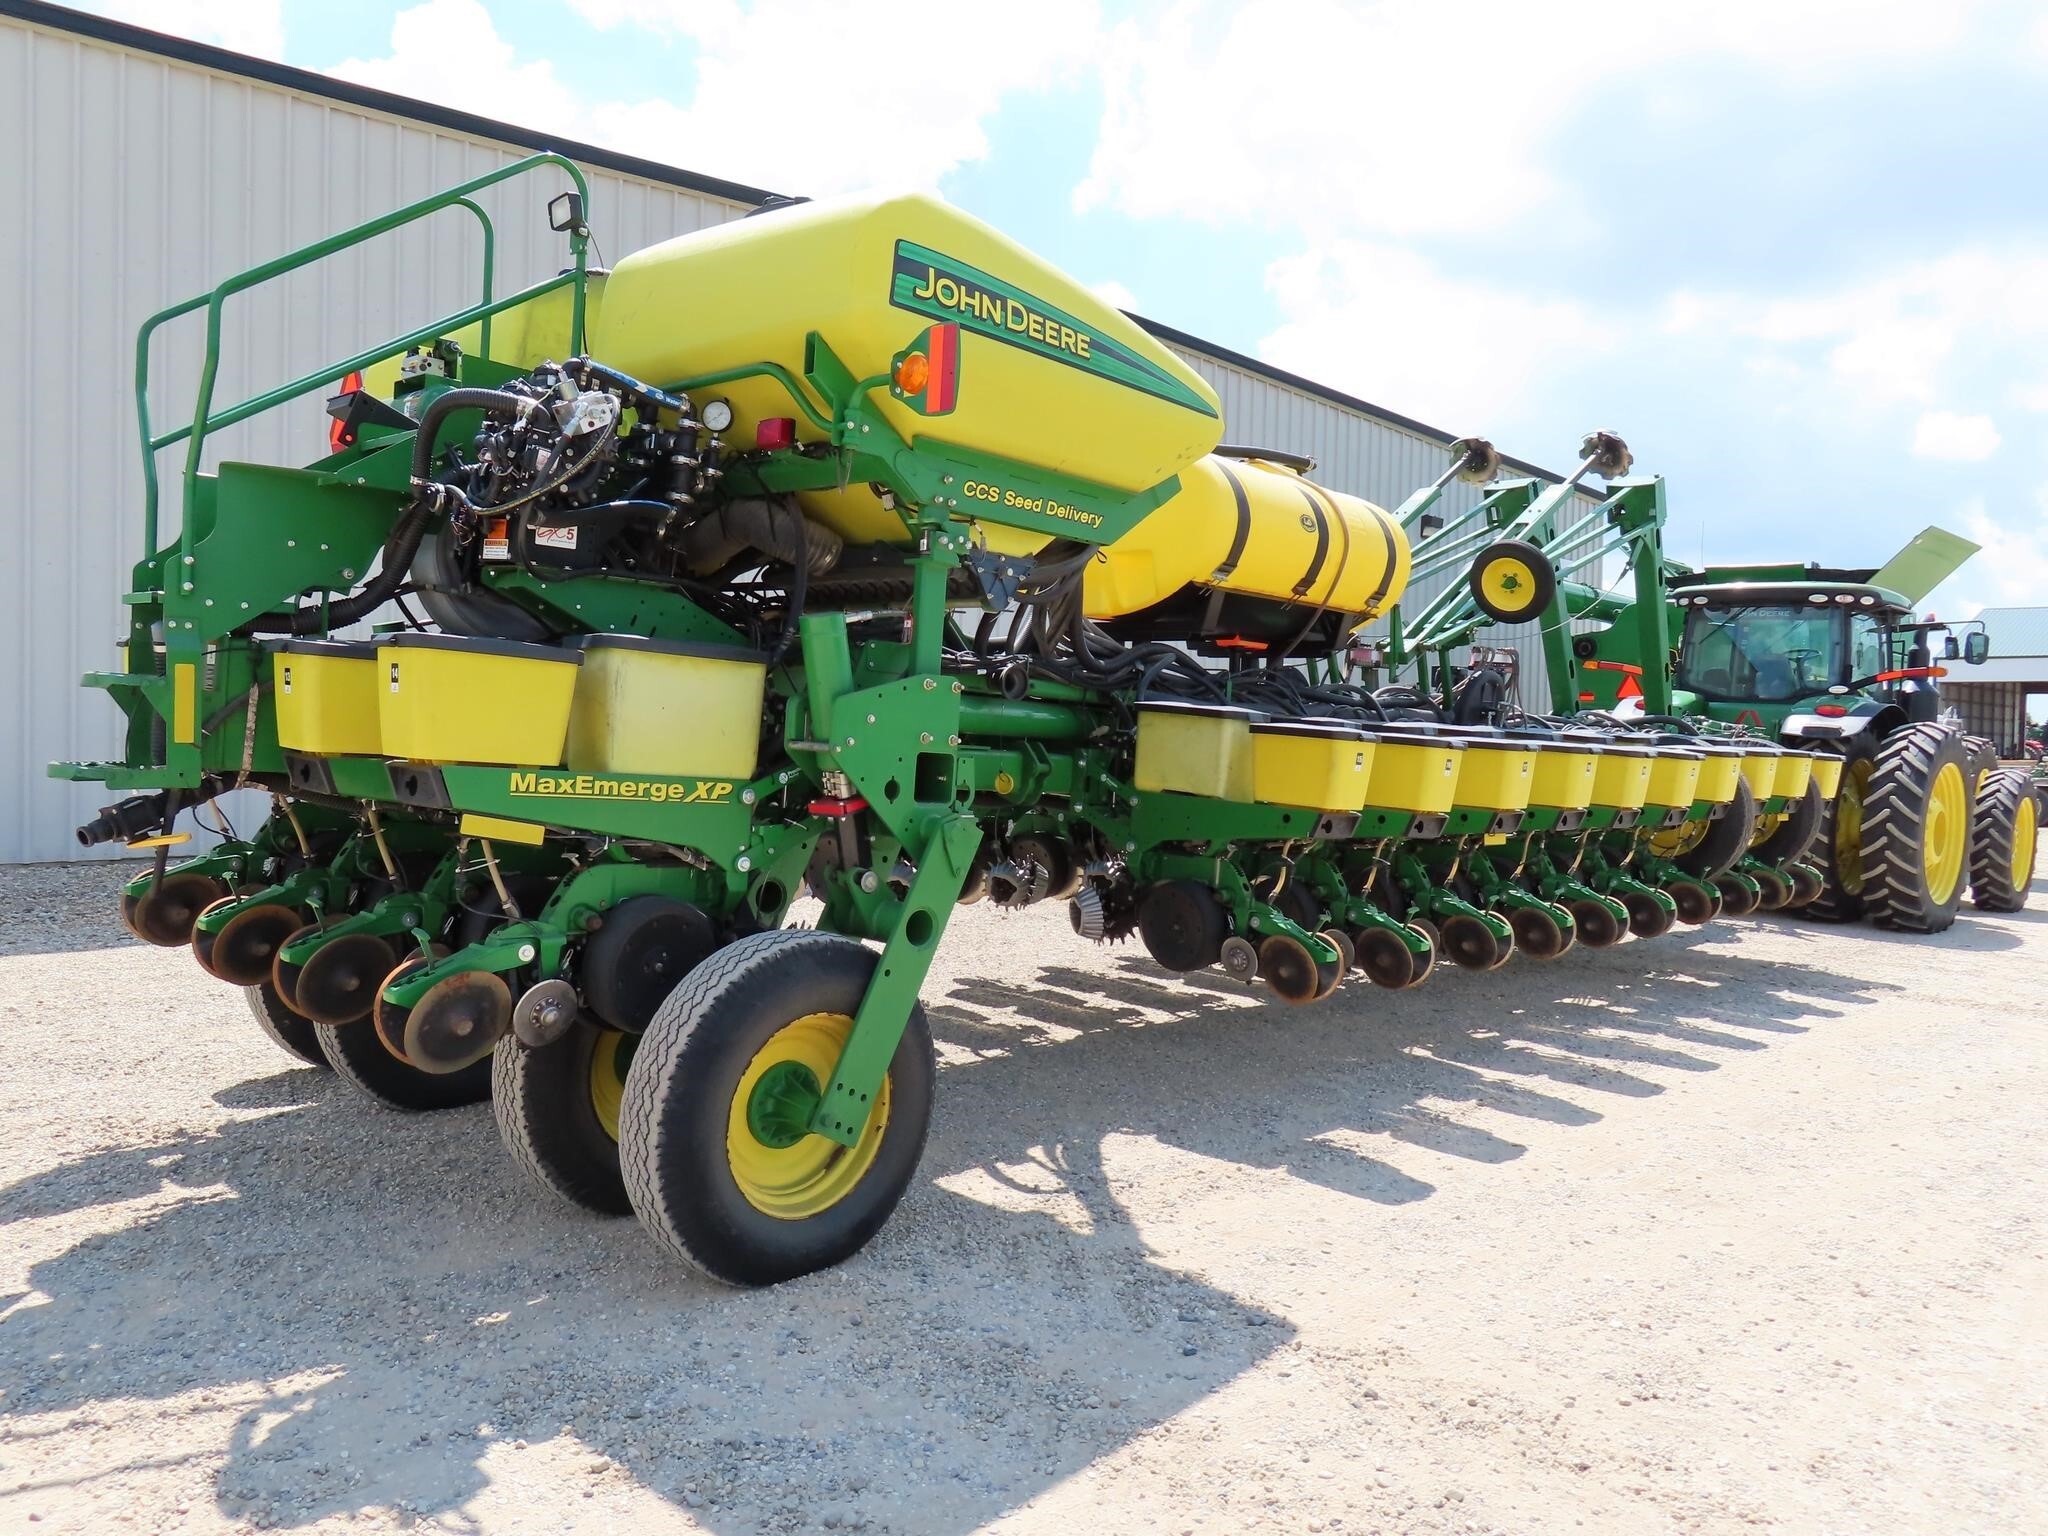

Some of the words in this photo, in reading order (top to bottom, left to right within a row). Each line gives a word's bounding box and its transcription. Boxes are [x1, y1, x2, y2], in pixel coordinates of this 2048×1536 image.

[915, 267, 1002, 325] JOHN
[1006, 298, 1091, 358] DEERE
[963, 481, 1000, 502] CCS
[1004, 490, 1043, 513] Seed
[1046, 501, 1104, 529] Delivery
[566, 528, 575, 541] 5
[510, 772, 685, 802] MaxEmerge
[683, 781, 734, 803] XP
